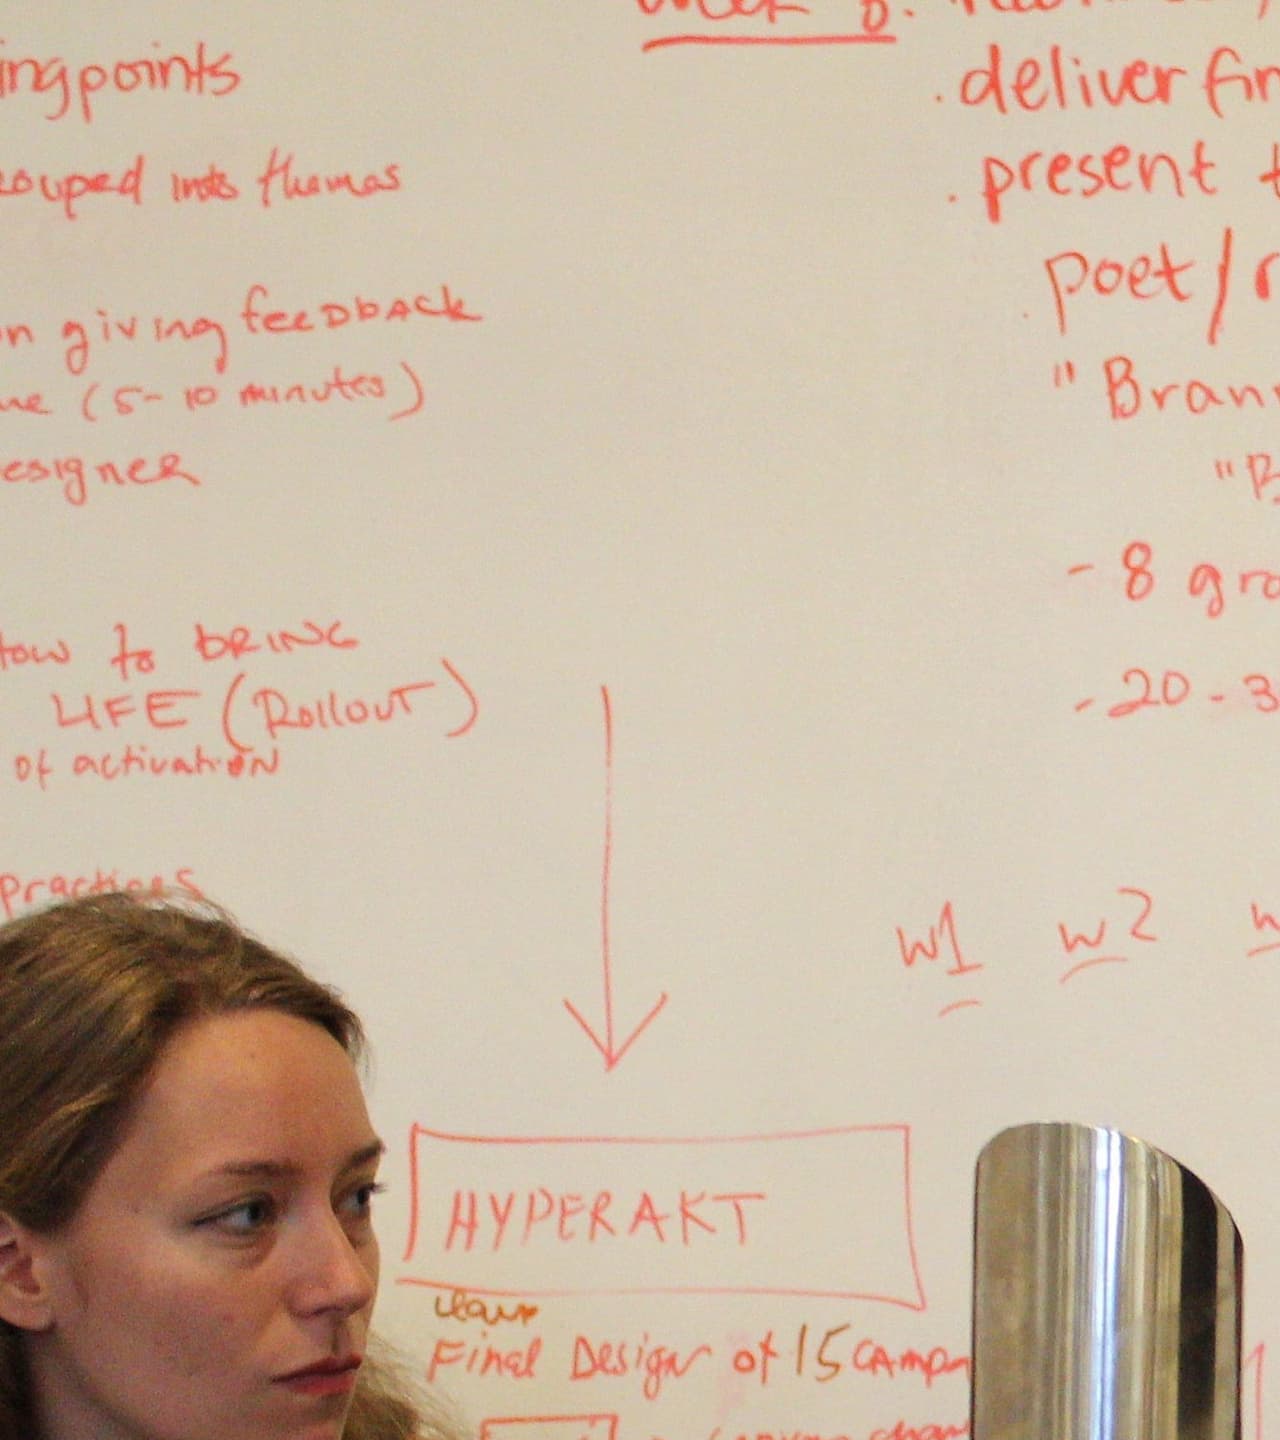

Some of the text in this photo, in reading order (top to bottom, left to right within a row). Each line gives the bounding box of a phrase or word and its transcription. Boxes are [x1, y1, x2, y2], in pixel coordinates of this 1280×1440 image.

[960, 44, 1187, 115] deliver
[982, 140, 1217, 224] present
[62, 310, 228, 376] giving
[1122, 541, 1154, 601] 8
[110, 623, 155, 680] to
[445, 1190, 765, 1251] HYPERAKT
[424, 1332, 542, 1384] Final
[570, 1334, 711, 1400] Design
[796, 1324, 850, 1382] 15
